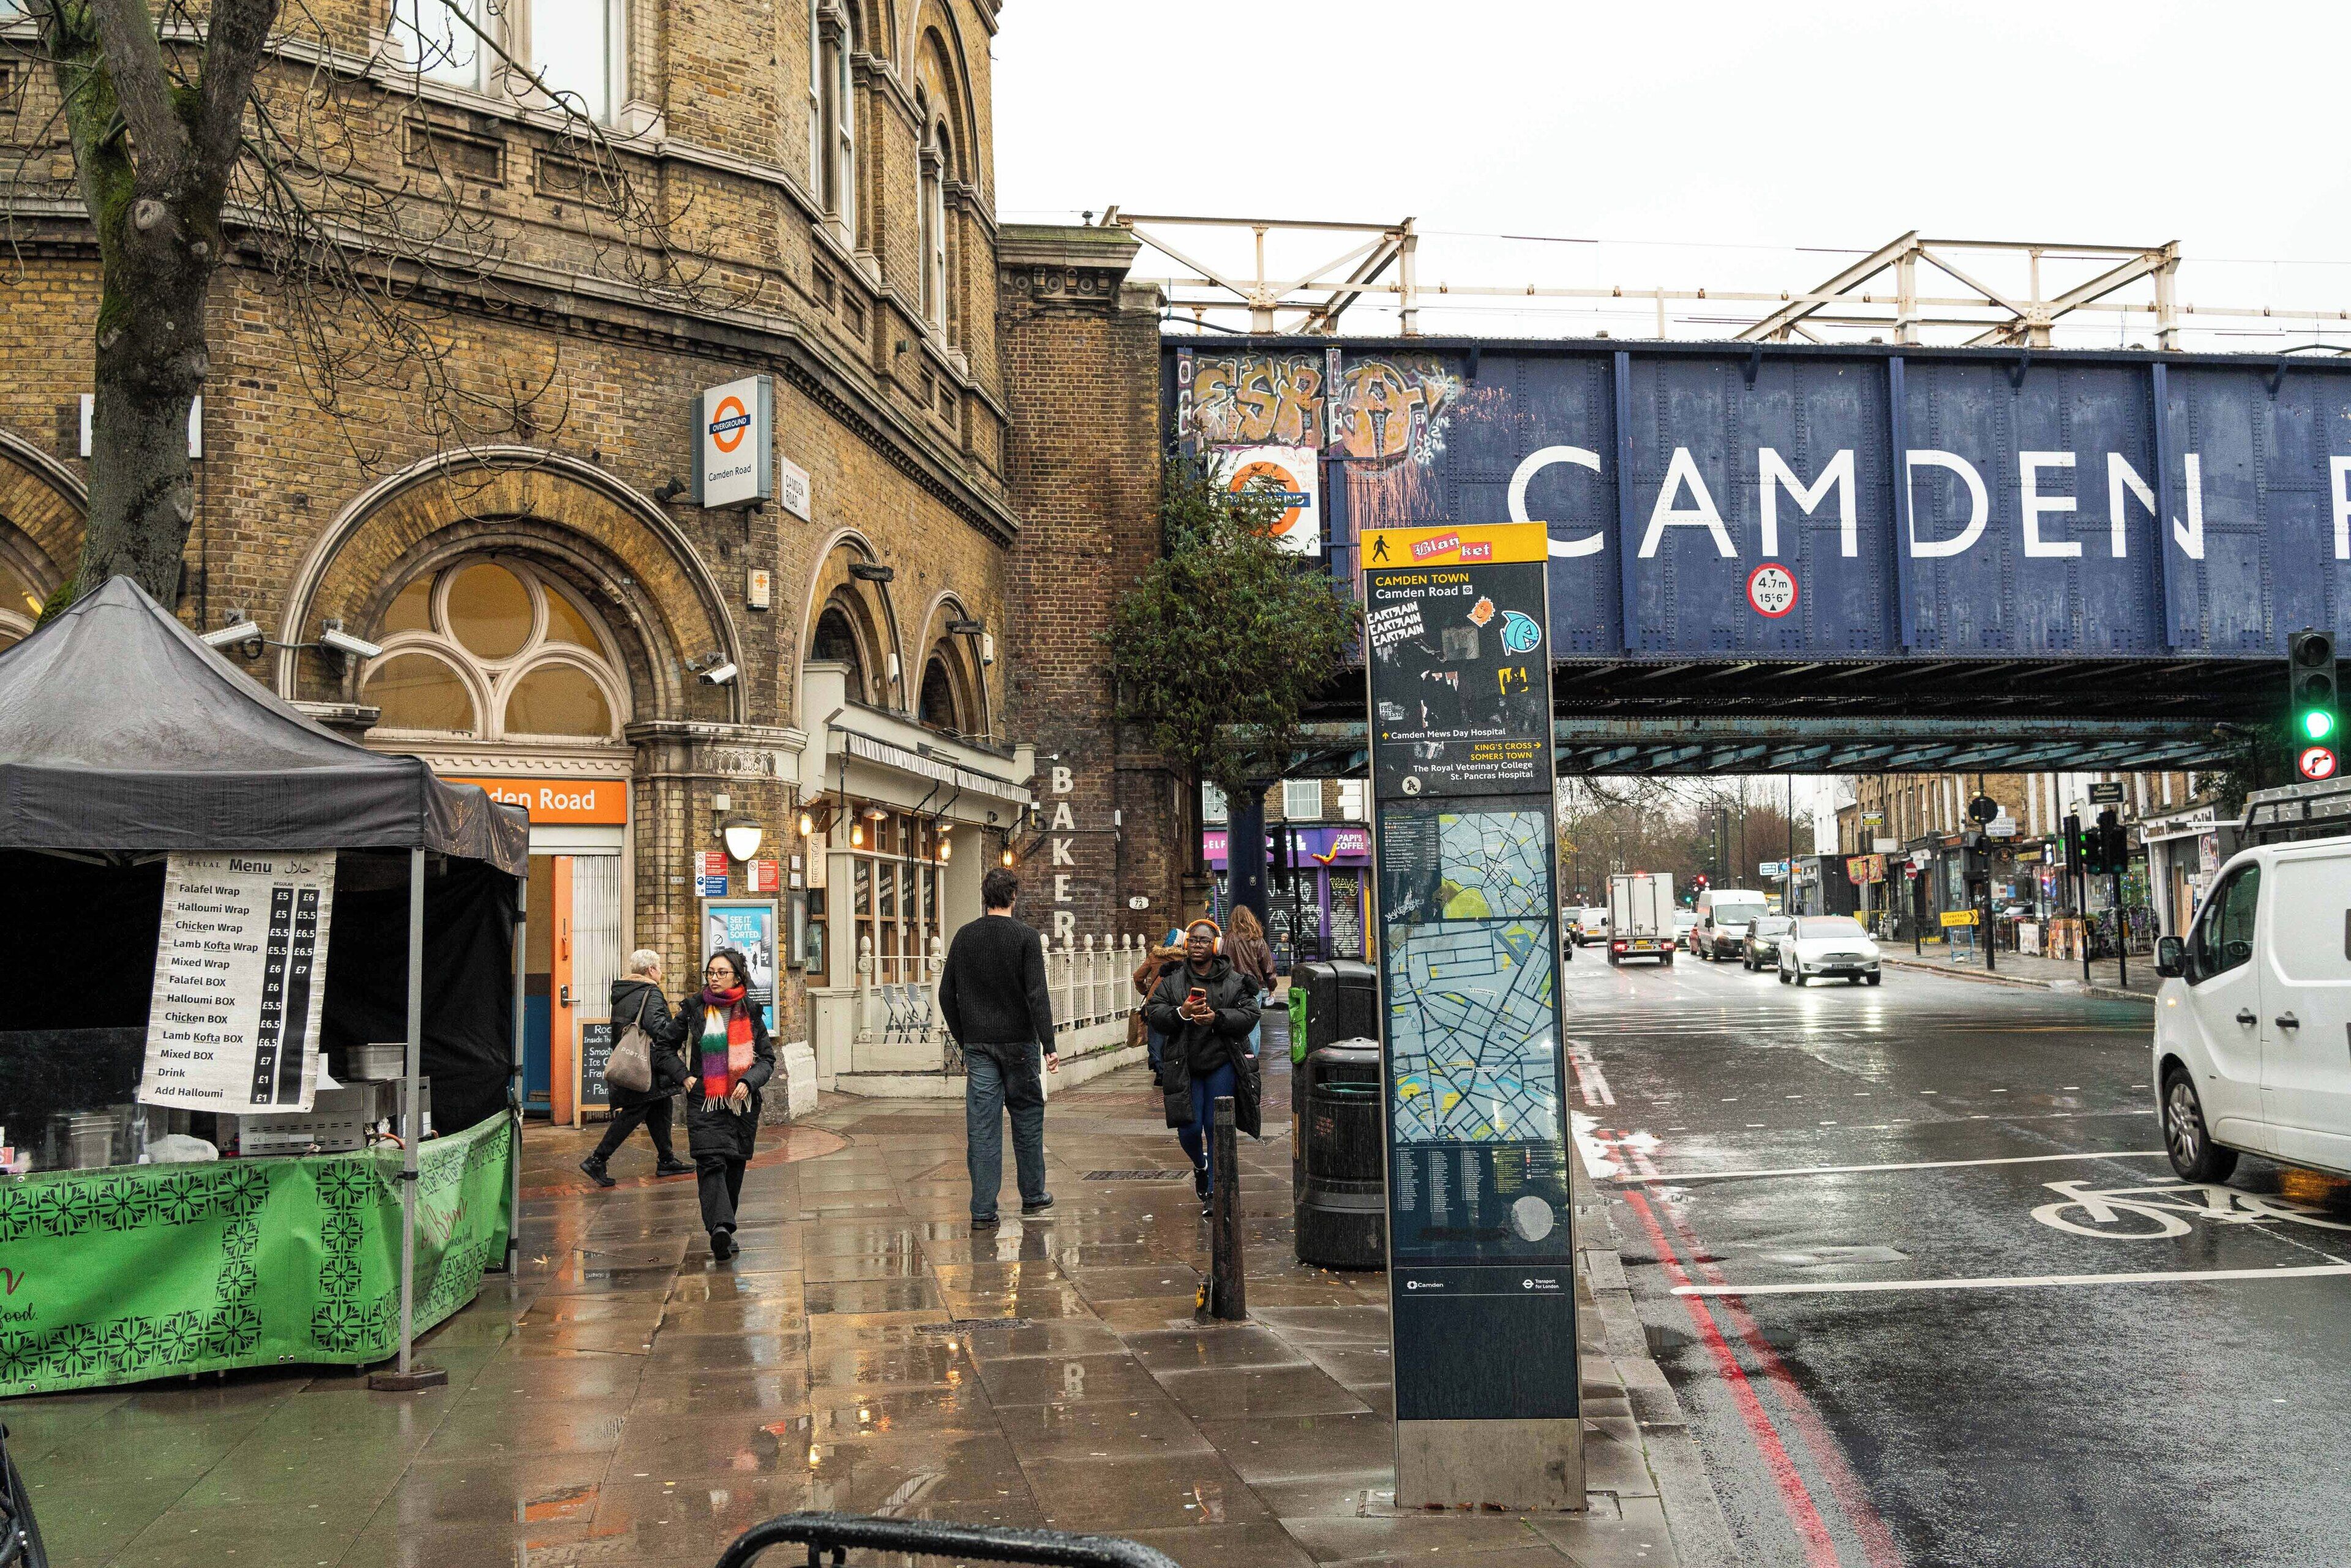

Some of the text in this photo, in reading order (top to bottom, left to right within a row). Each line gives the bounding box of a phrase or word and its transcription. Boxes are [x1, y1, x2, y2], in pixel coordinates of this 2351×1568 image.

[712, 417, 747, 432] OVERGROUND
[709, 464, 751, 482] Camden Road
[786, 475, 804, 497] CAMDEN
[786, 490, 798, 508] ROAD
[1507, 445, 2205, 560] CAMDEN
[1461, 543, 1490, 556] ket
[1376, 573, 1469, 586] CAMDEN TOWN
[1376, 586, 1458, 599] Camden Road
[1471, 728, 1506, 737] Hospital
[1431, 764, 1453, 773] Royal
[1456, 763, 1498, 771] Veterinary
[540, 788, 595, 810] Road
[230, 859, 272, 873] Menu
[1051, 767, 1076, 953] BAKER
[285, 861, 311, 874] حلال
[179, 885, 212, 894] Falafel
[215, 887, 240, 897] Wrap
[855, 880, 868, 894] PASTRIES
[857, 894, 866, 906] CAKES
[178, 903, 222, 913] Halloumi
[225, 905, 250, 916] Wrap
[176, 921, 214, 931] Chicken
[217, 923, 243, 934] Wrap
[173, 939, 313, 956] Lamb Kofta Wrap £5.5 £6.5
[171, 958, 201, 967] Mixed
[204, 959, 230, 970] Wrap
[170, 975, 203, 985] Falafel
[206, 978, 226, 986] BOX
[167, 994, 212, 1005] Halloumi
[165, 1012, 204, 1022] Chicken
[208, 1015, 228, 1024] BOX
[163, 1031, 190, 1040] Lamb
[193, 1033, 220, 1042] Kofta
[160, 1049, 190, 1059] Mixed
[193, 1051, 214, 1060] BOX
[158, 1068, 185, 1077] Drink
[155, 1087, 175, 1095] Add
[178, 1088, 223, 1098] Halloumi
